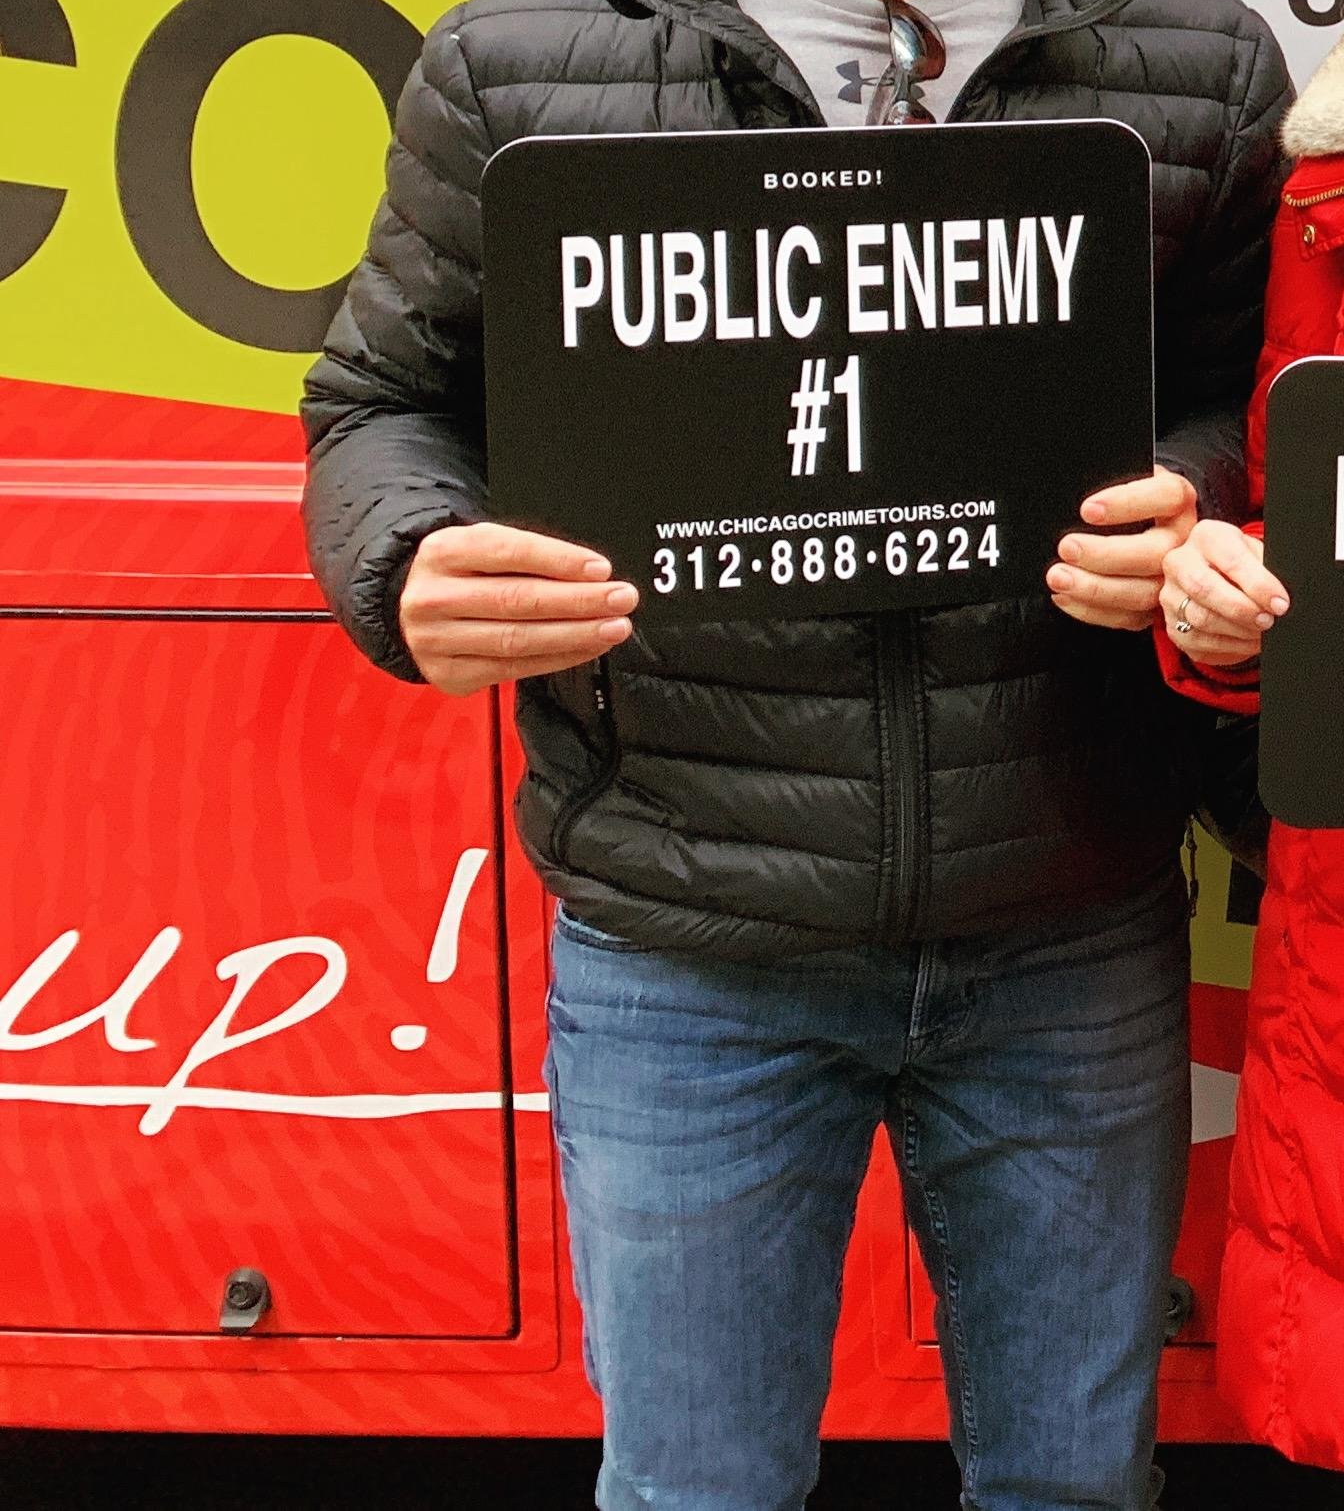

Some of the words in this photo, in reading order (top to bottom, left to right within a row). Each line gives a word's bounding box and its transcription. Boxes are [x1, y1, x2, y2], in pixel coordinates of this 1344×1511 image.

[763, 170, 883, 189] BOOKED!
[560, 225, 822, 348] PUBLIC
[846, 215, 1085, 333] ENEMY
[786, 355, 863, 476] #1
[655, 500, 996, 540] WWW.CHICAGOCRIMETOURS.COM
